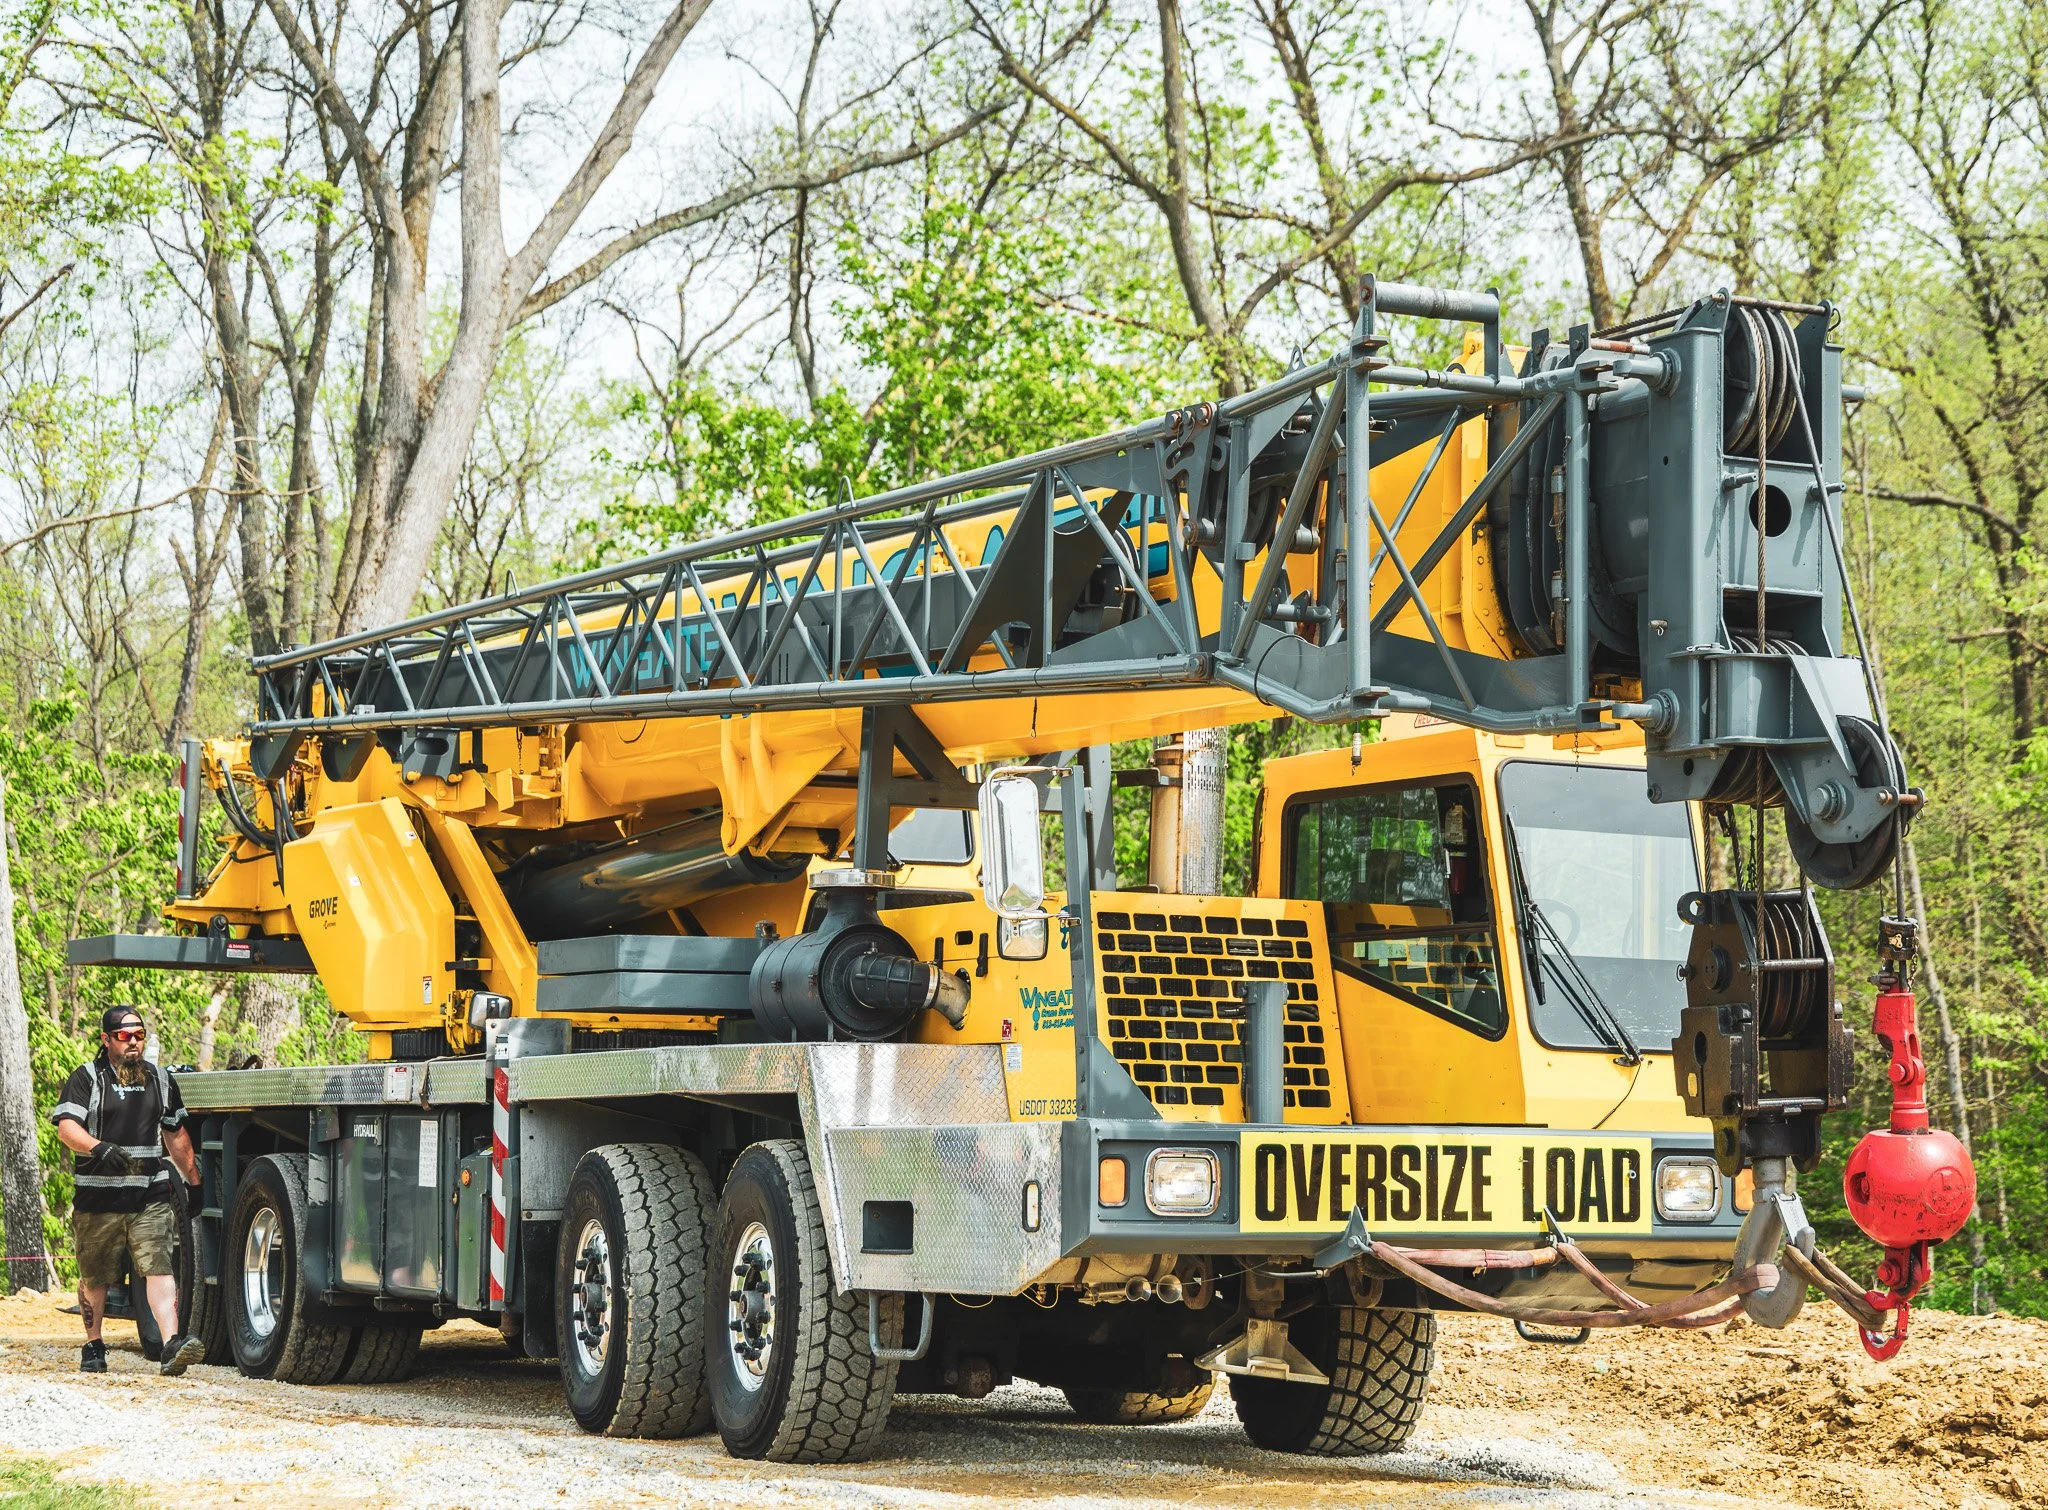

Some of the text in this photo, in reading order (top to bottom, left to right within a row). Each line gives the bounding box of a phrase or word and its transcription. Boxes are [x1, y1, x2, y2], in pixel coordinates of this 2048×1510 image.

[569, 622, 721, 689] WINGATE
[309, 896, 338, 918] GROVE
[1019, 986, 1073, 1009] WINGAT
[1019, 1099, 1048, 1116] USDOT
[1255, 1143, 1641, 1224] OVERSIZE LOAD
